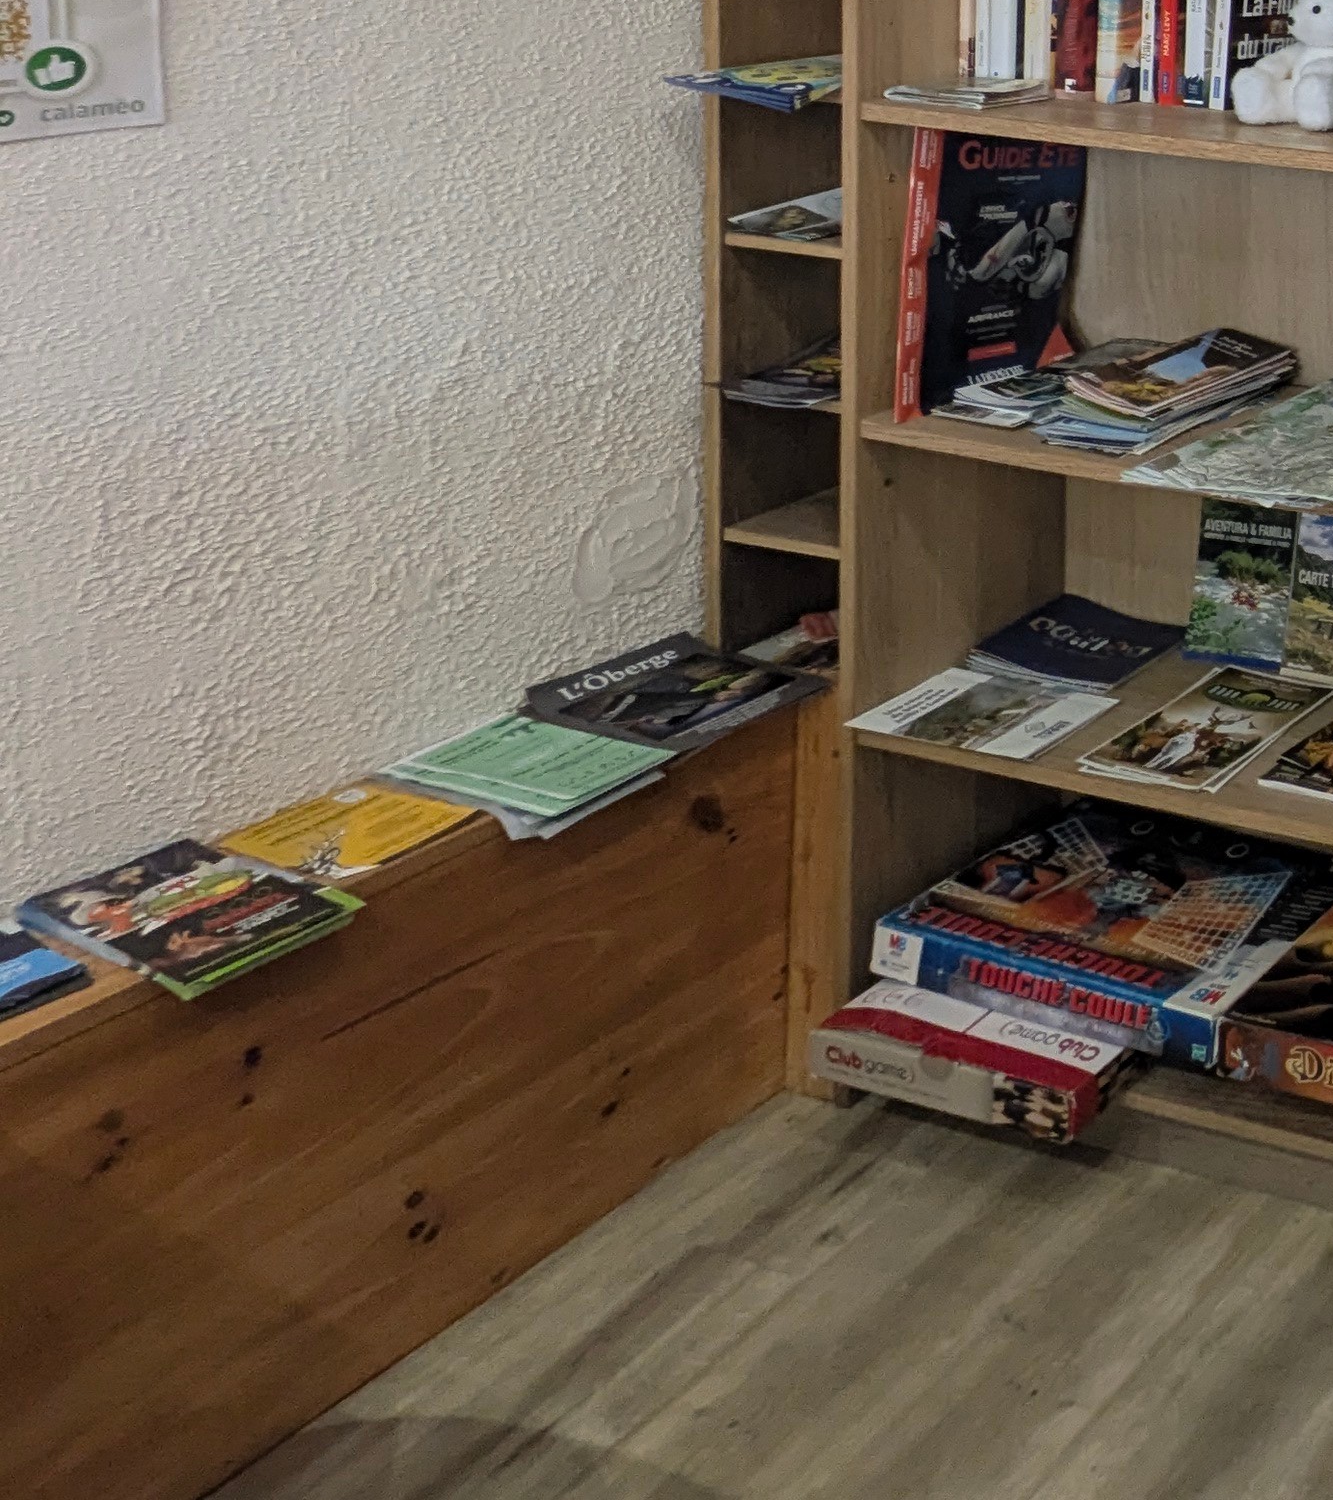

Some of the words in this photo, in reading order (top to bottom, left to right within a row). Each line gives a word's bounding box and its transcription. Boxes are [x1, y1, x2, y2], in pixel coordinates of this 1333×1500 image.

[1162, 10, 1170, 30] LEVY
[958, 139, 1032, 170] GUIDE
[1204, 518, 1248, 535] AVENTURA
[1250, 524, 1257, 535] &
[1259, 524, 1292, 540] FAMILIA
[1299, 569, 1329, 587] CARTE
[557, 650, 679, 701] L'Ôberge
[823, 1044, 863, 1069] Club
[1057, 1036, 1101, 1062] Club
